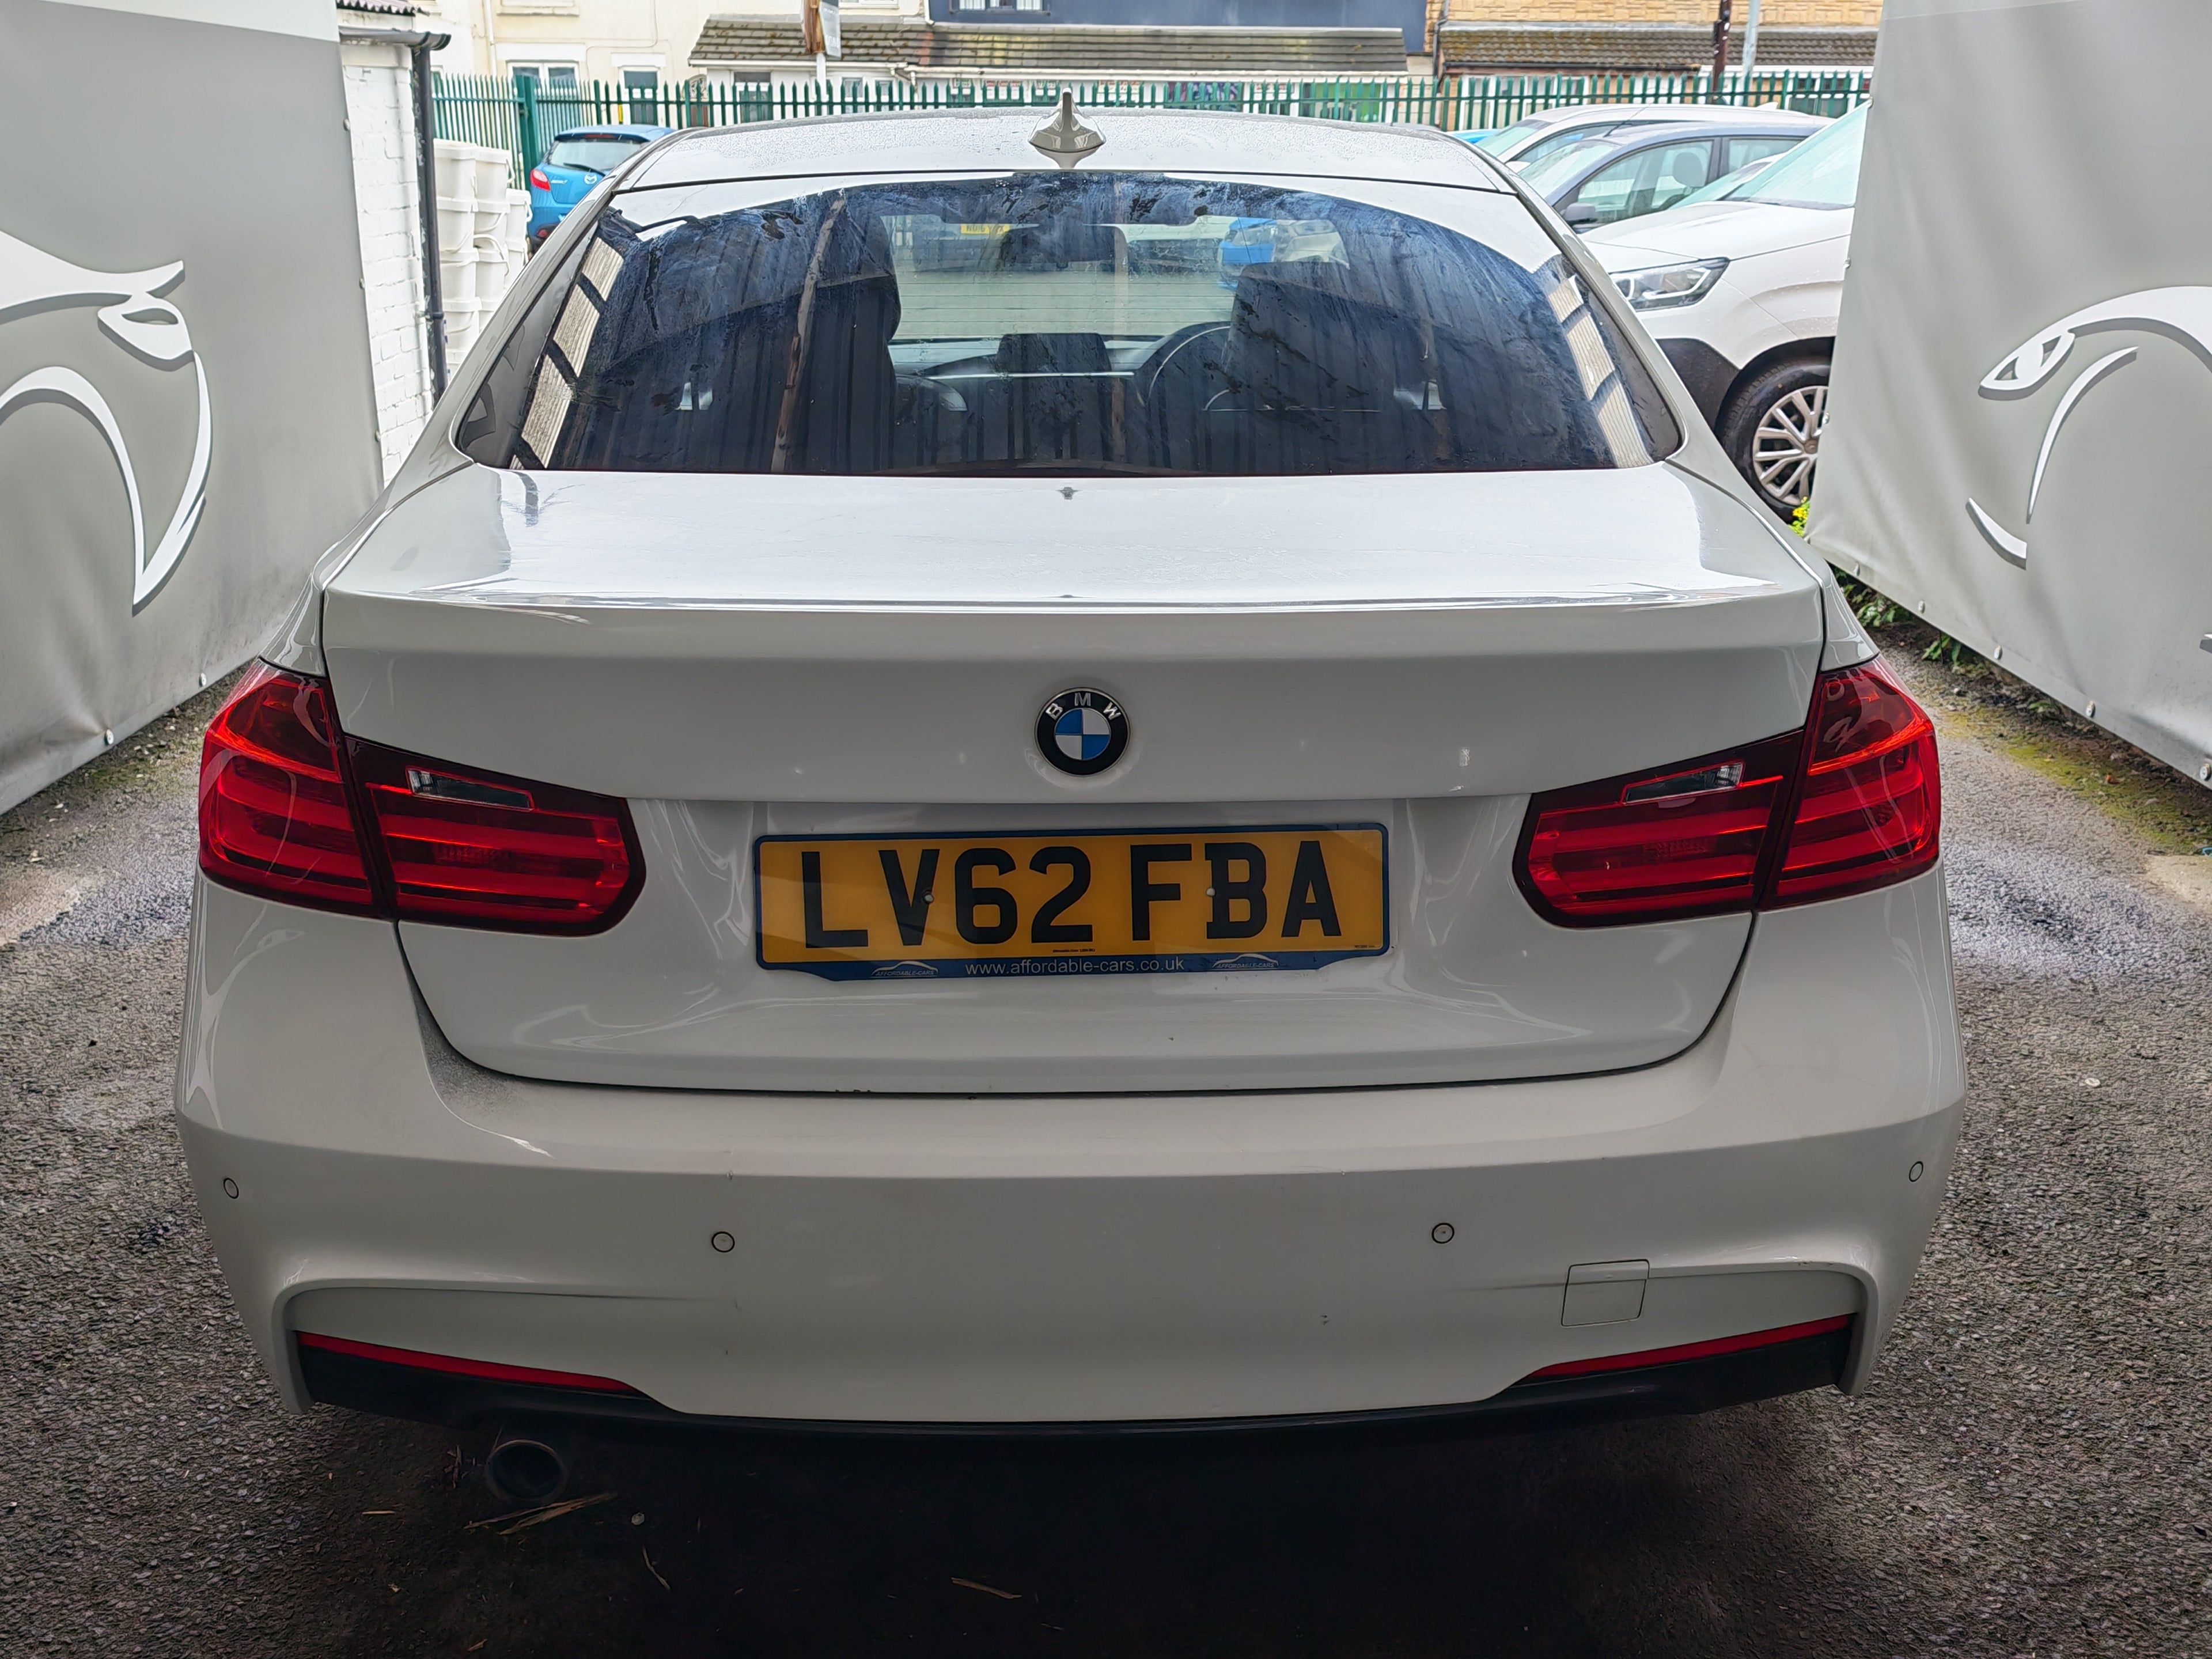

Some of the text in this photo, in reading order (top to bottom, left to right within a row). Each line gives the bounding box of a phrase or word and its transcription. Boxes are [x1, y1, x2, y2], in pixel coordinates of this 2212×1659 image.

[1046, 692, 1121, 720] BMW
[801, 840, 1342, 948] LV62 FBA
[965, 956, 1185, 975] www.affordable-cars.co.uk
